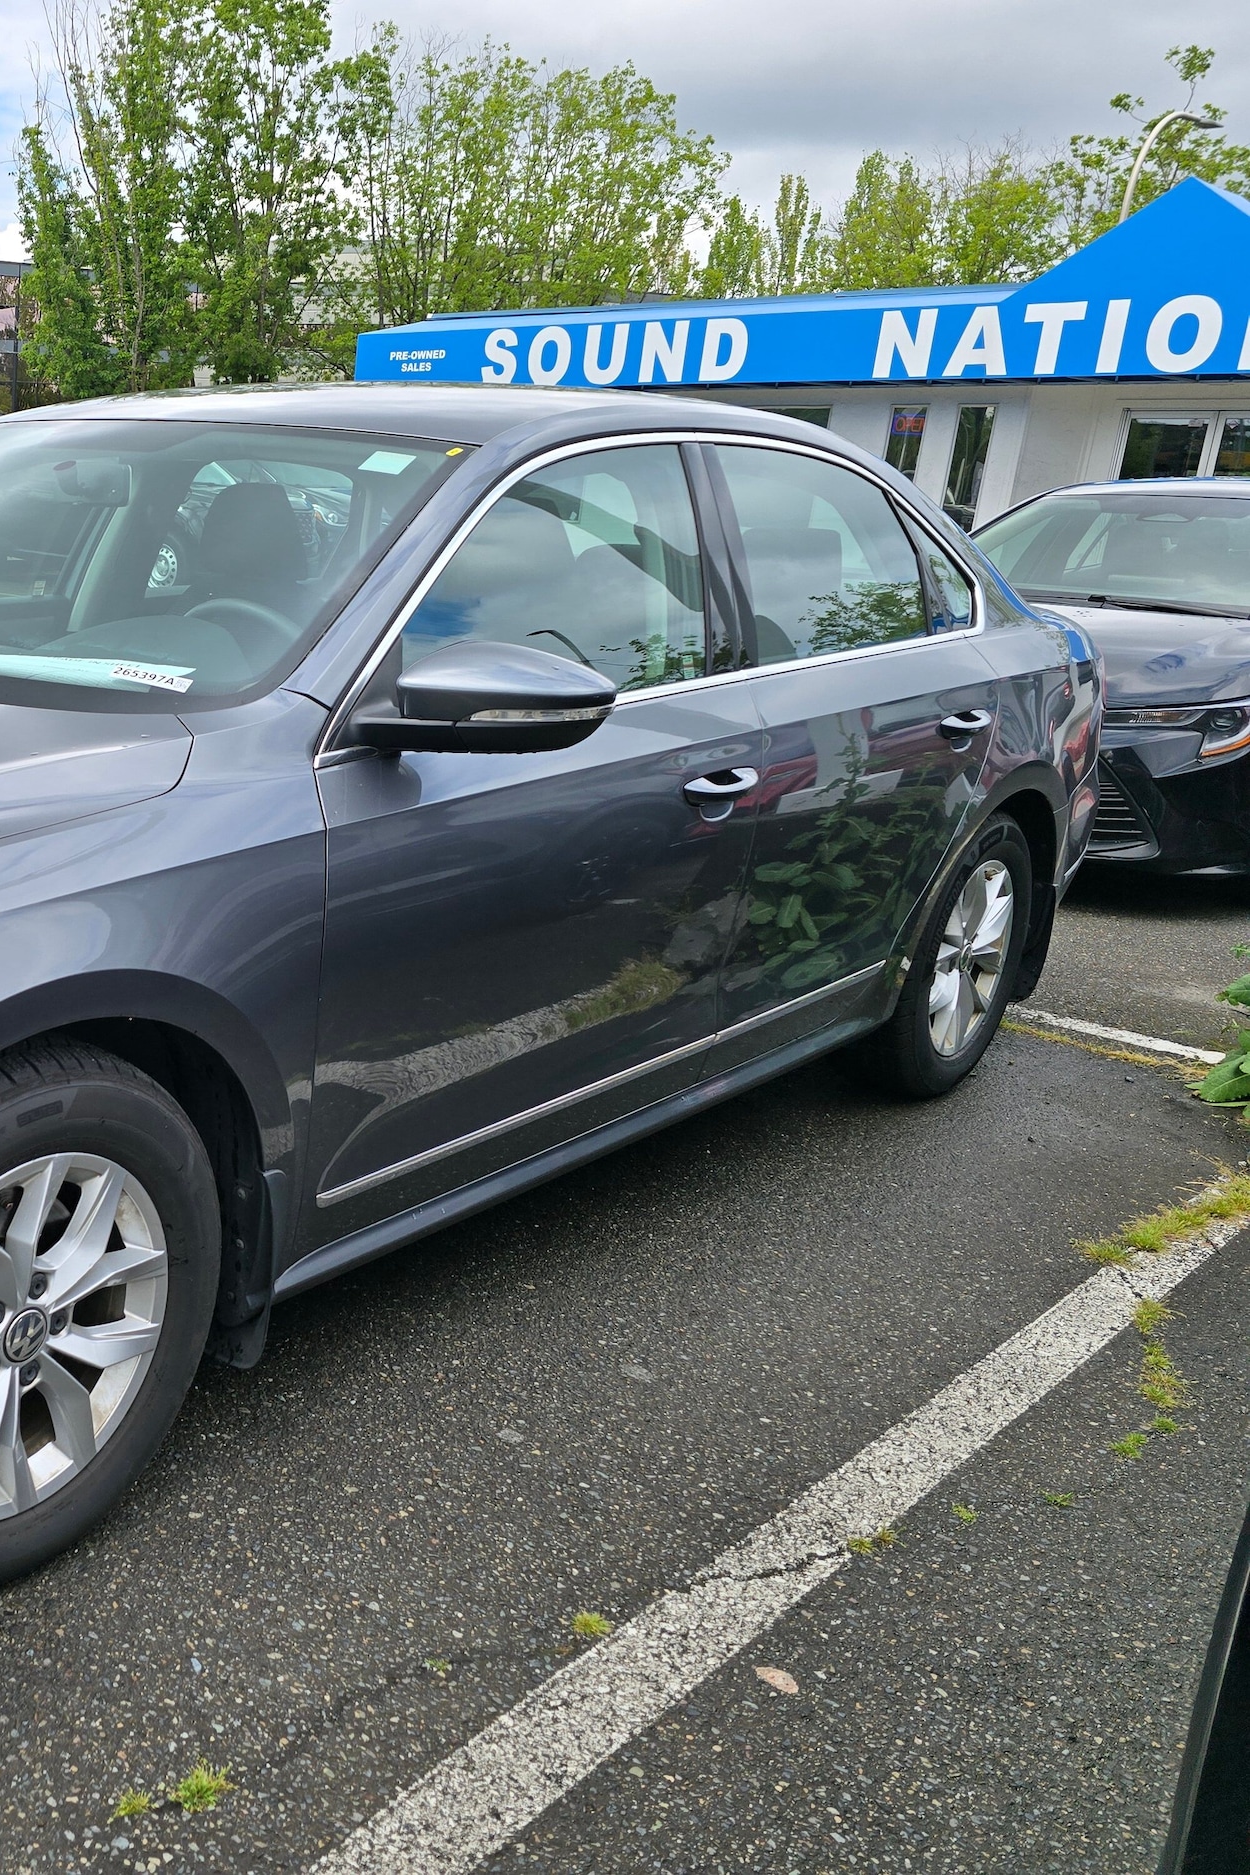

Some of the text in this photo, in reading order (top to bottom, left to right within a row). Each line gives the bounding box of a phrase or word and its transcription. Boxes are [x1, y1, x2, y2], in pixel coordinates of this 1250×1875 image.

[481, 294, 1250, 385] SOUND NATIO
[389, 349, 446, 361] PRE-OWNED
[400, 362, 432, 372] SALES
[113, 666, 175, 687] 265397A
